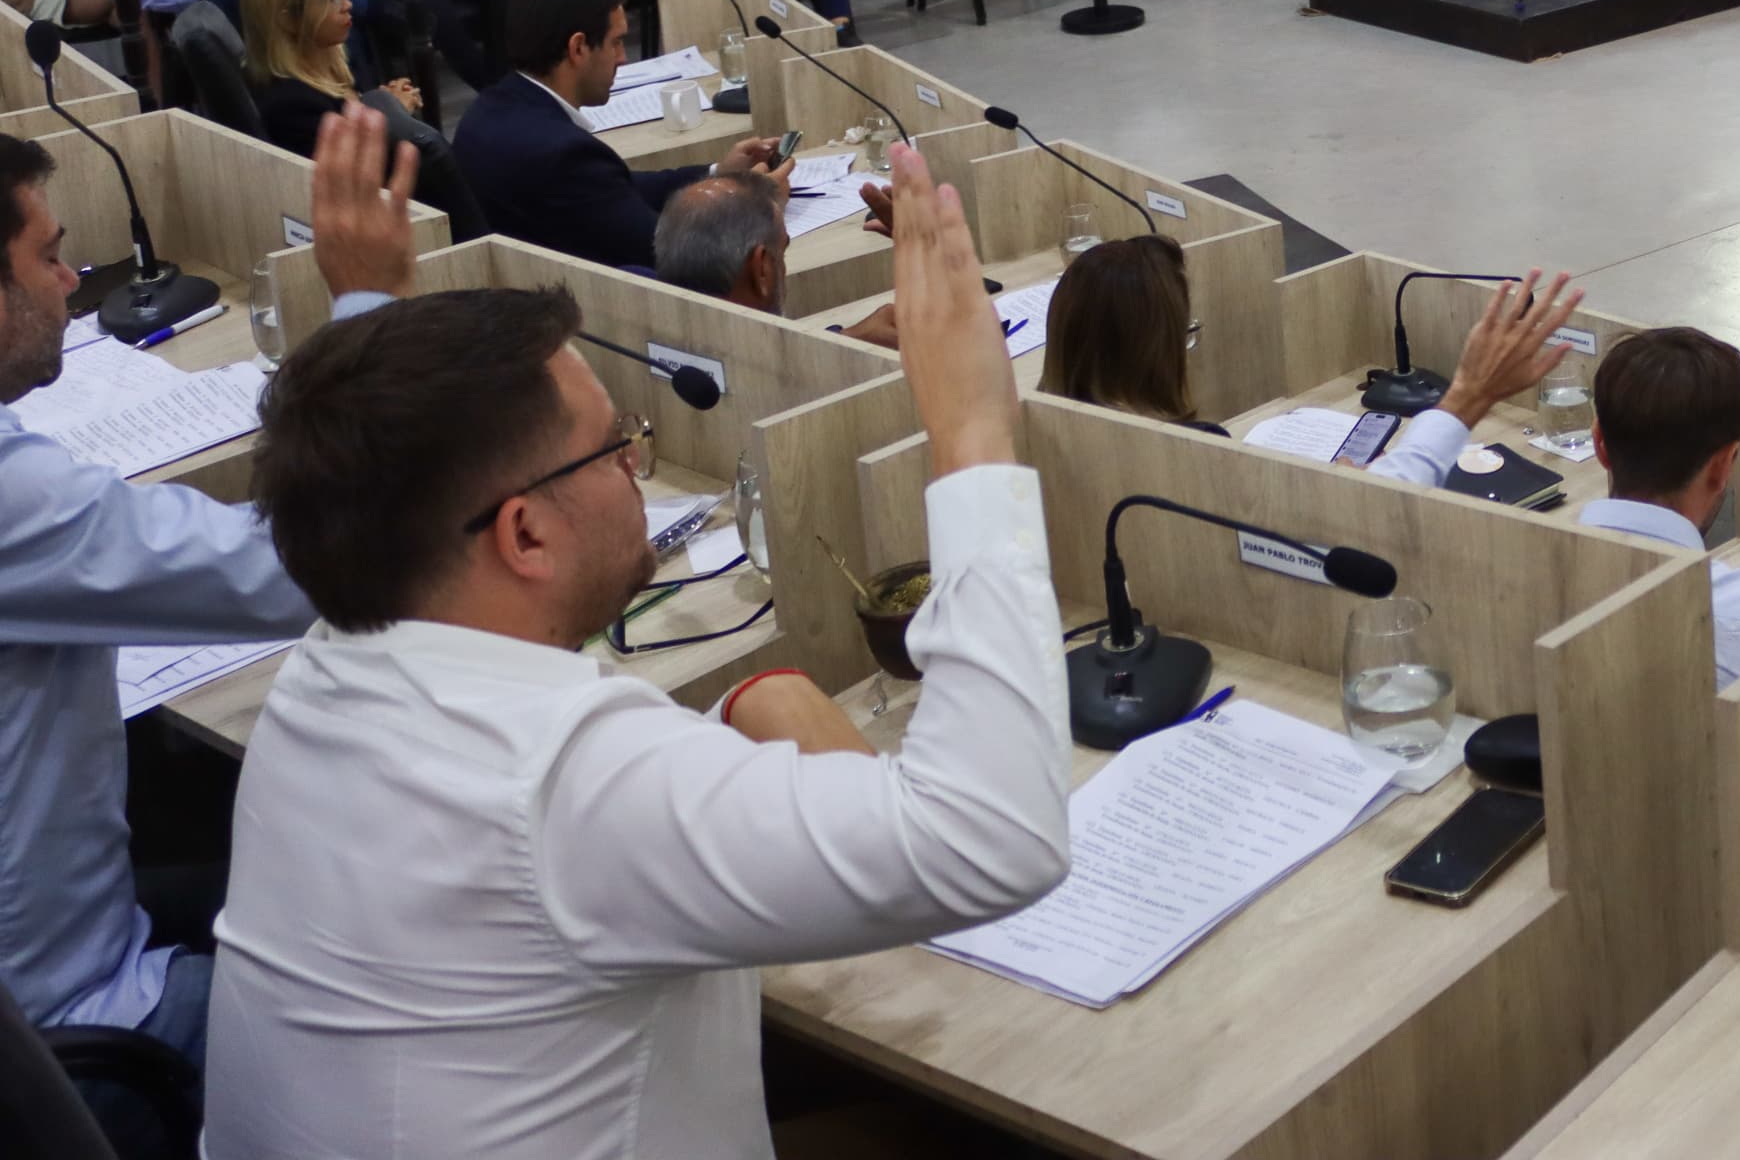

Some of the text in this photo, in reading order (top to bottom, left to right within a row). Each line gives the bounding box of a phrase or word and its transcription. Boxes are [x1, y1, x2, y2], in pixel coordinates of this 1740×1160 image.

[1243, 541, 1324, 569] JUAN PABLO TROV
